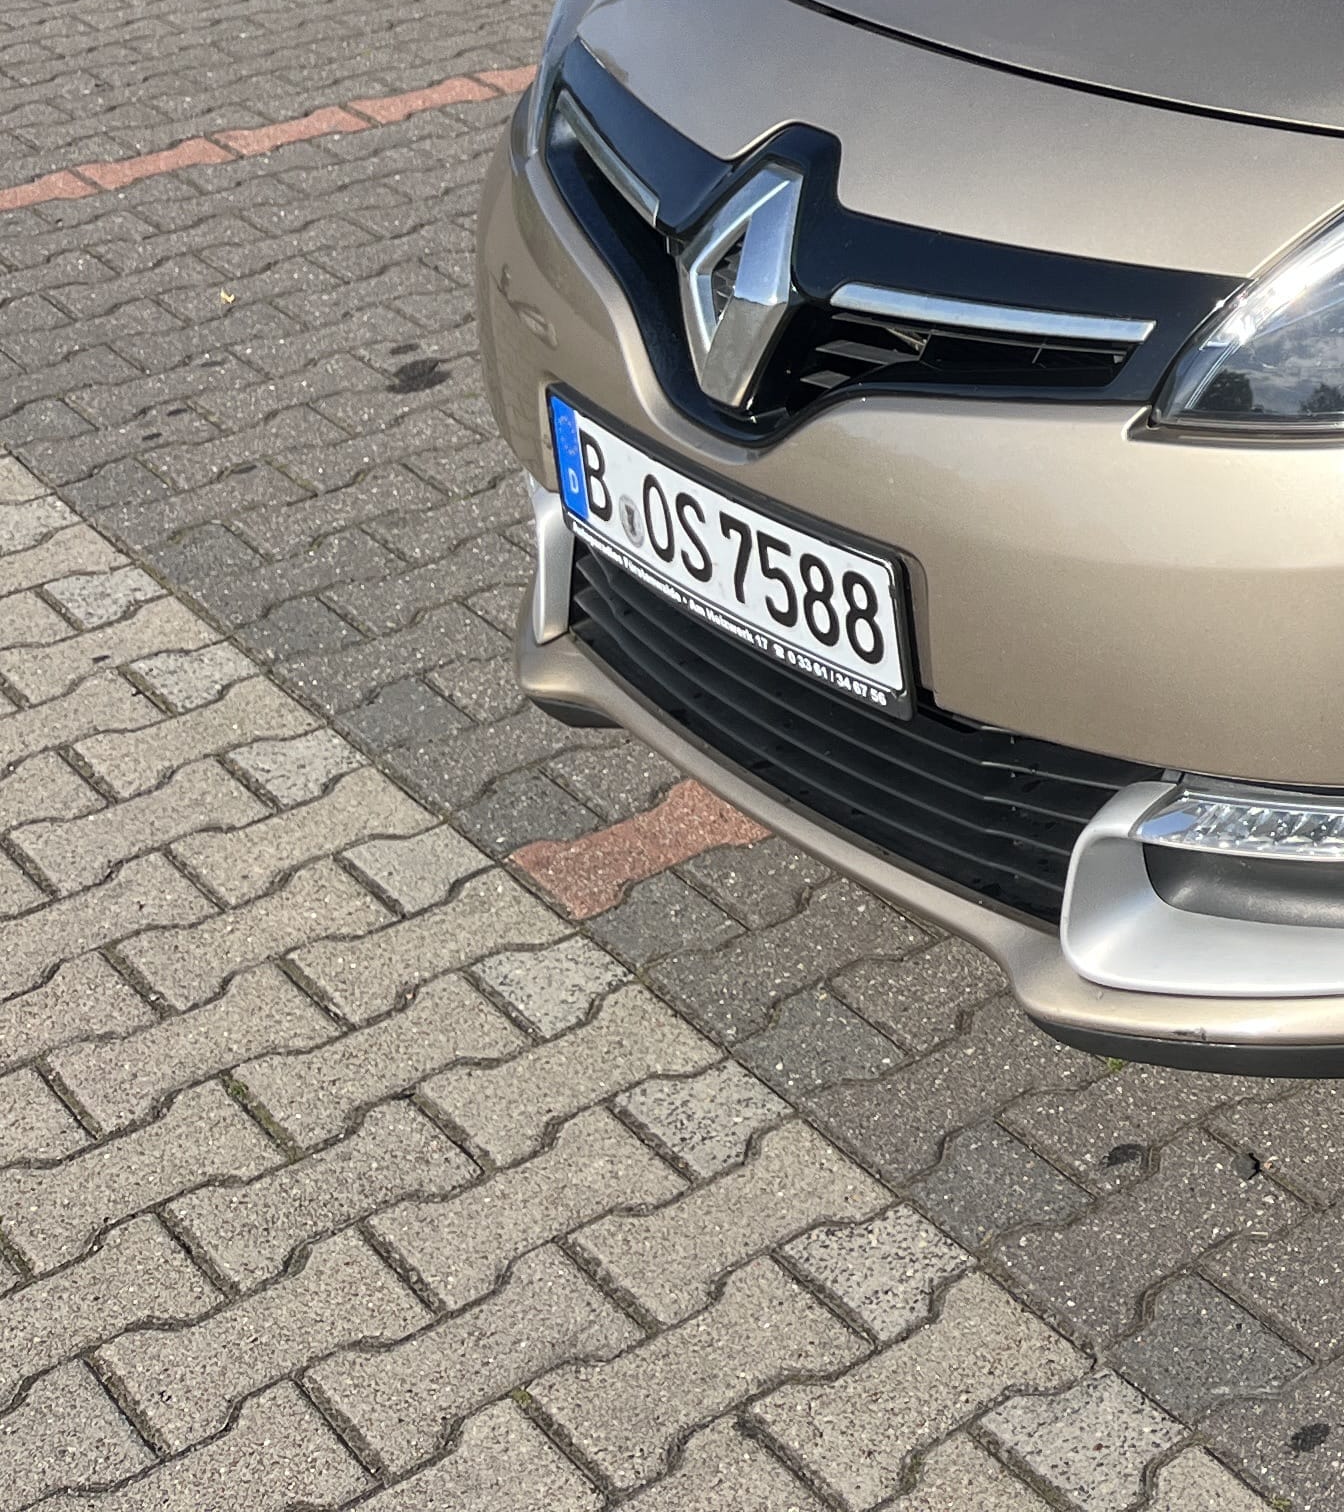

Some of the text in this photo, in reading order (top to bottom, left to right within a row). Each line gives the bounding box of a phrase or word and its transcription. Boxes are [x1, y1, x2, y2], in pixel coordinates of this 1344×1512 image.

[568, 467, 579, 494] D
[579, 429, 885, 664] B OS 7588
[754, 634, 768, 650] 17
[787, 650, 796, 665] 0
[797, 654, 812, 672] 33
[835, 672, 851, 690] 34
